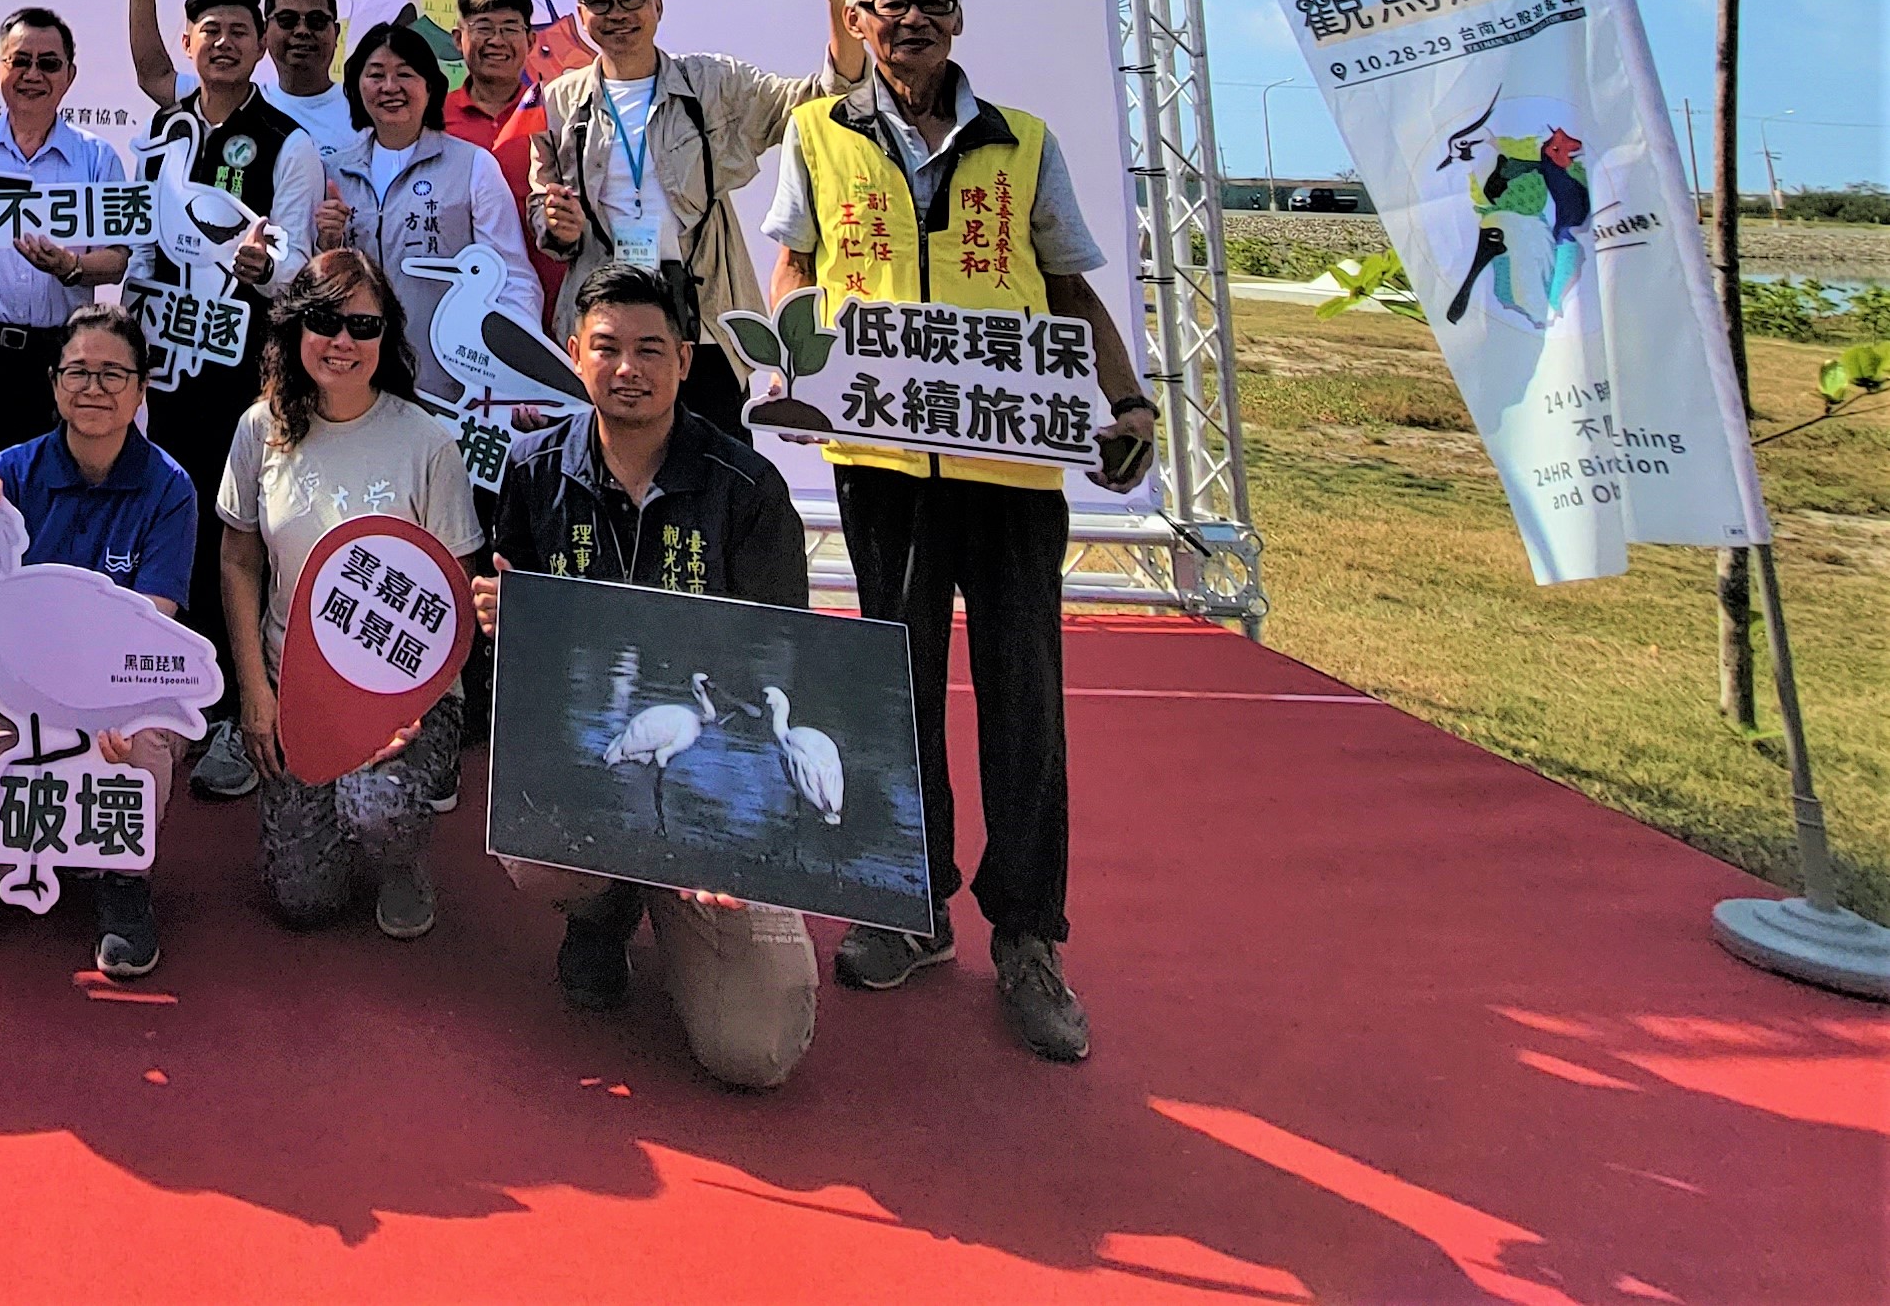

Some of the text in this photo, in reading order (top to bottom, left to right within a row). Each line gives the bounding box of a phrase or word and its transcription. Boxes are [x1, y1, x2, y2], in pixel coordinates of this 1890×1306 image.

[1354, 36, 1452, 74] 10.28-29
[405, 212, 423, 257] 方一
[960, 186, 992, 279] 陳昆和
[127, 282, 244, 359] 不追逐
[839, 302, 1091, 379] 低碳環保
[841, 373, 1093, 454] 永續旅遊
[1533, 462, 1573, 487] 24HR
[1553, 486, 1584, 510] and
[341, 545, 451, 634] 雲嘉南
[124, 654, 185, 672] 黑面琵鷺
[316, 586, 430, 679] 風景區
[160, 676, 199, 685] Spoonbill
